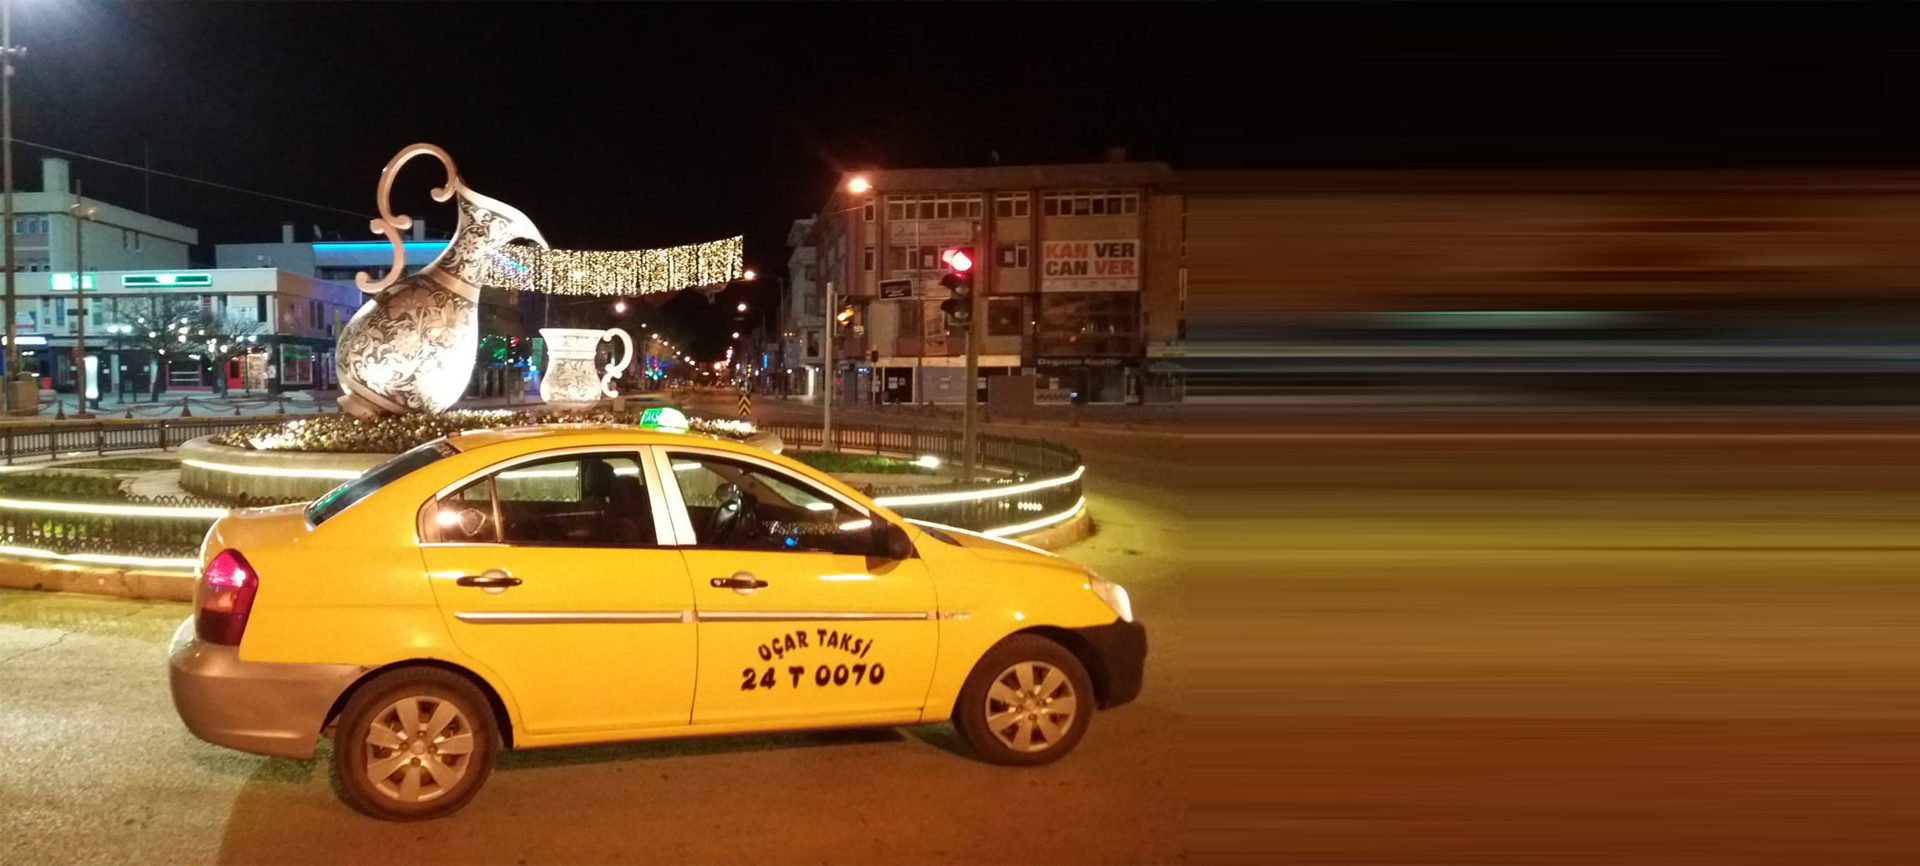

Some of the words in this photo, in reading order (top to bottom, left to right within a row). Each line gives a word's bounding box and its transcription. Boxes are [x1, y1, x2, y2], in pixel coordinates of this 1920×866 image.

[1045, 243, 1089, 259] KAN
[1094, 242, 1136, 258] VER
[1045, 260, 1089, 276] CAN
[1094, 260, 1136, 275] VER
[740, 666, 777, 692] 24
[788, 666, 806, 689] T
[814, 663, 885, 687] 0070
